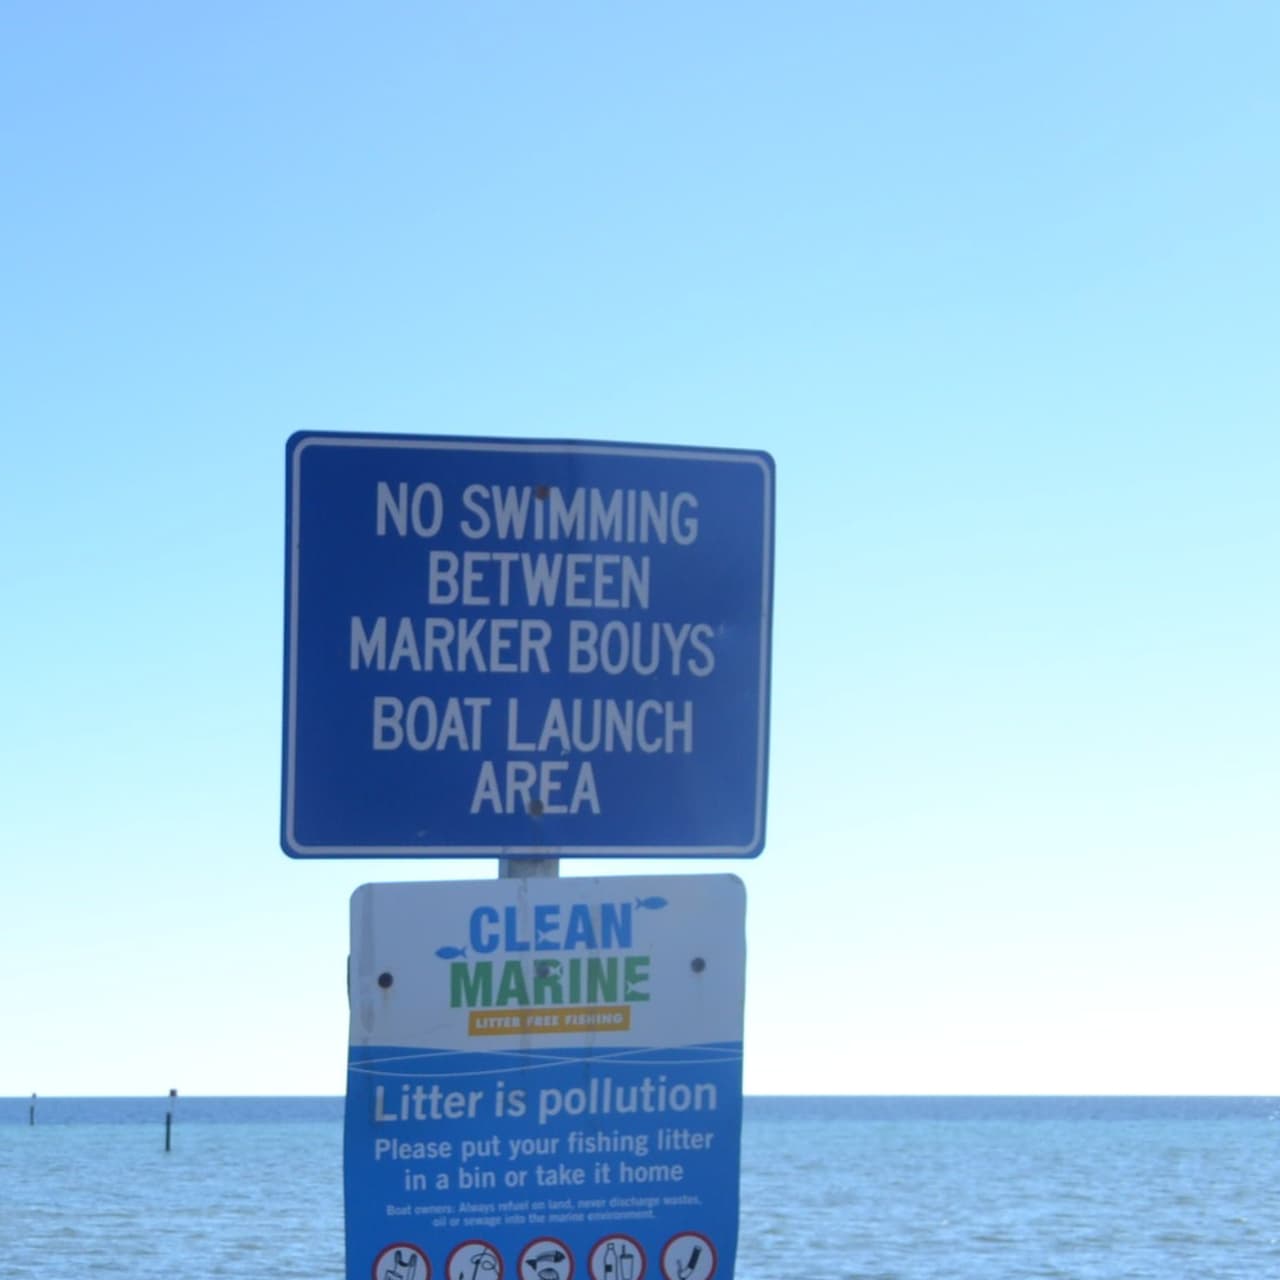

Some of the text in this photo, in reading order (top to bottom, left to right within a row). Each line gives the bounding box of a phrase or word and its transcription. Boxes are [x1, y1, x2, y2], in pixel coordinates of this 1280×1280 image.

[375, 481, 699, 546] NO SWIMMING
[427, 550, 650, 609] BETWEEN
[349, 616, 716, 677] MARKER BOUYS
[371, 696, 694, 754] BOAT LAUNCH
[470, 761, 601, 815] AREA
[469, 902, 632, 954] CLEAN
[449, 956, 651, 1008] MARINE
[475, 1012, 624, 1030] LITTER FREE FISHING
[374, 1075, 718, 1125] Litter is pollution
[375, 1128, 714, 1162] Please put your fishing litter
[405, 1161, 684, 1191] in a bin or take it home
